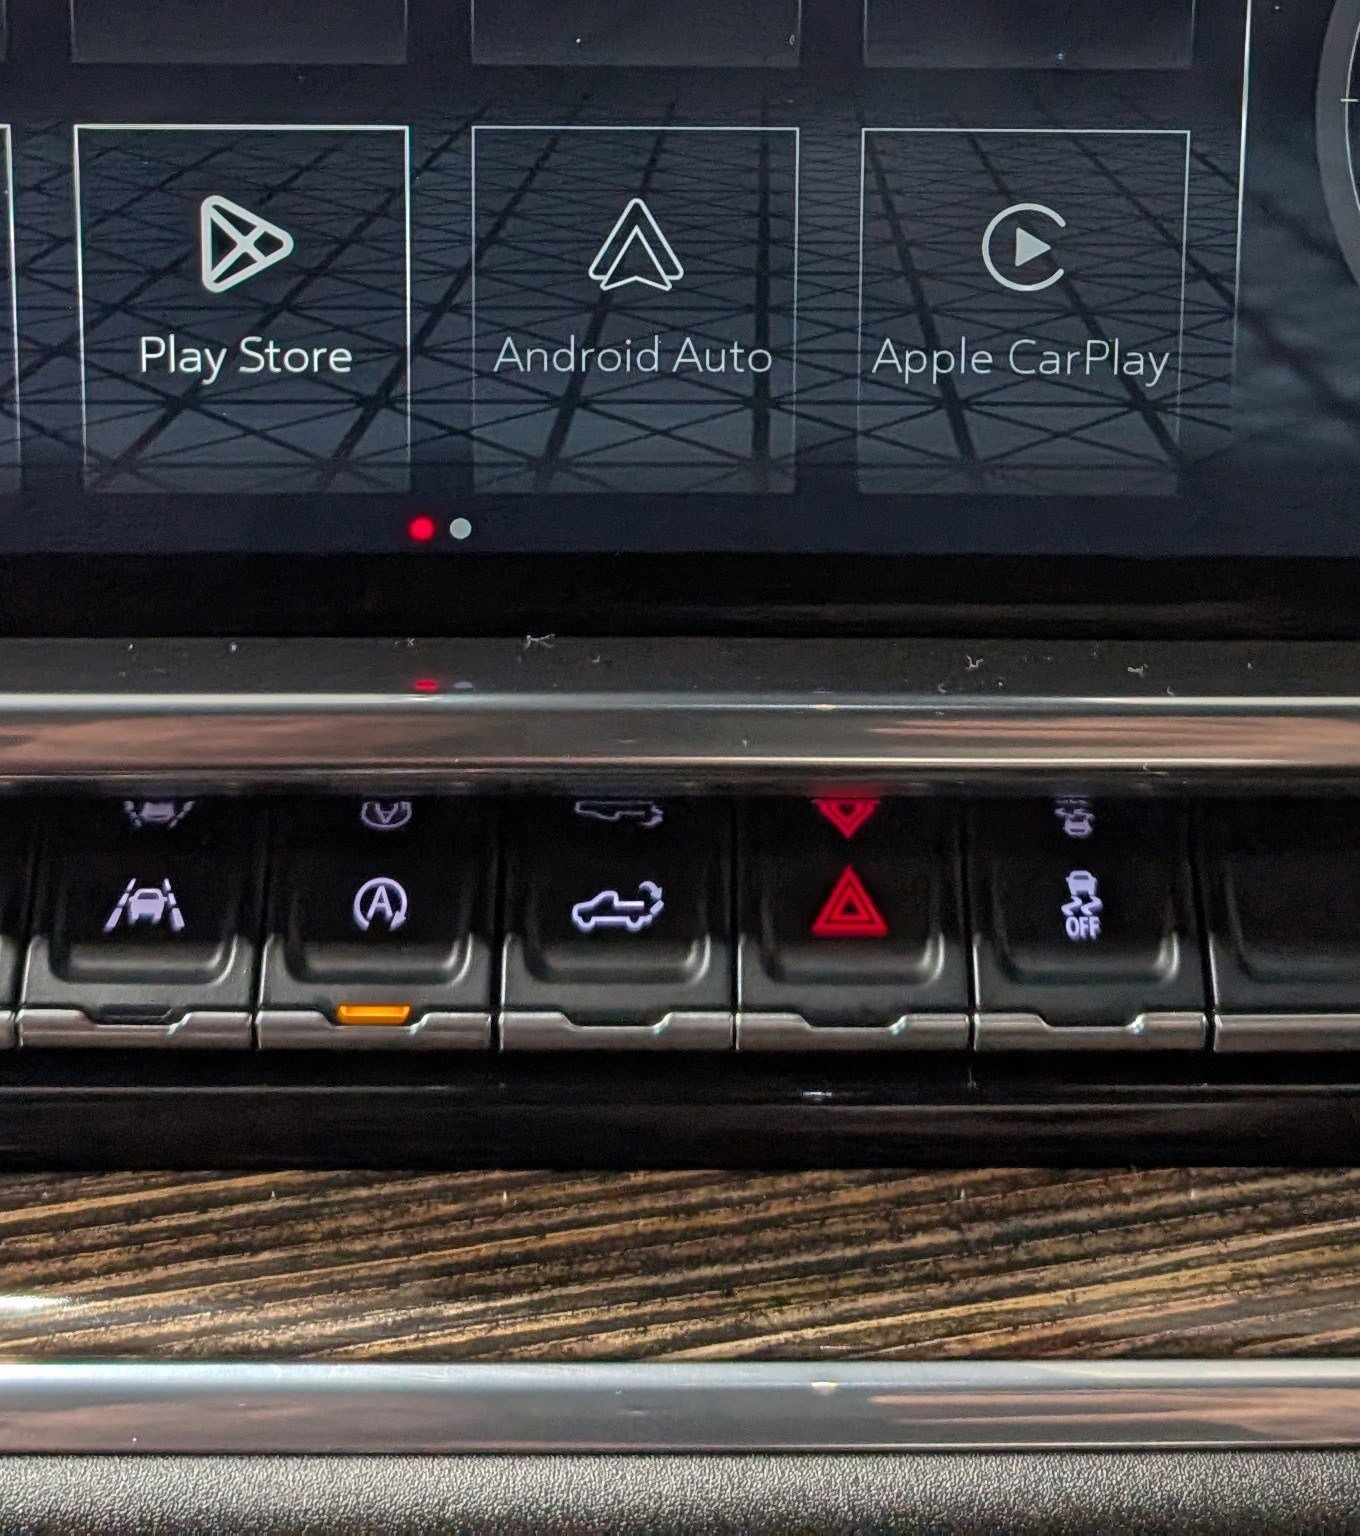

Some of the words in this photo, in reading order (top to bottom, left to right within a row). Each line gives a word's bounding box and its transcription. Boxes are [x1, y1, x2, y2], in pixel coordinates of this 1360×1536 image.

[140, 333, 227, 384] Play
[239, 336, 353, 373] Store
[493, 334, 659, 373] Android
[671, 336, 772, 373] Auto
[871, 336, 993, 385] Apple
[1009, 337, 1170, 388] CarPlay
[1065, 916, 1101, 940] OFF
